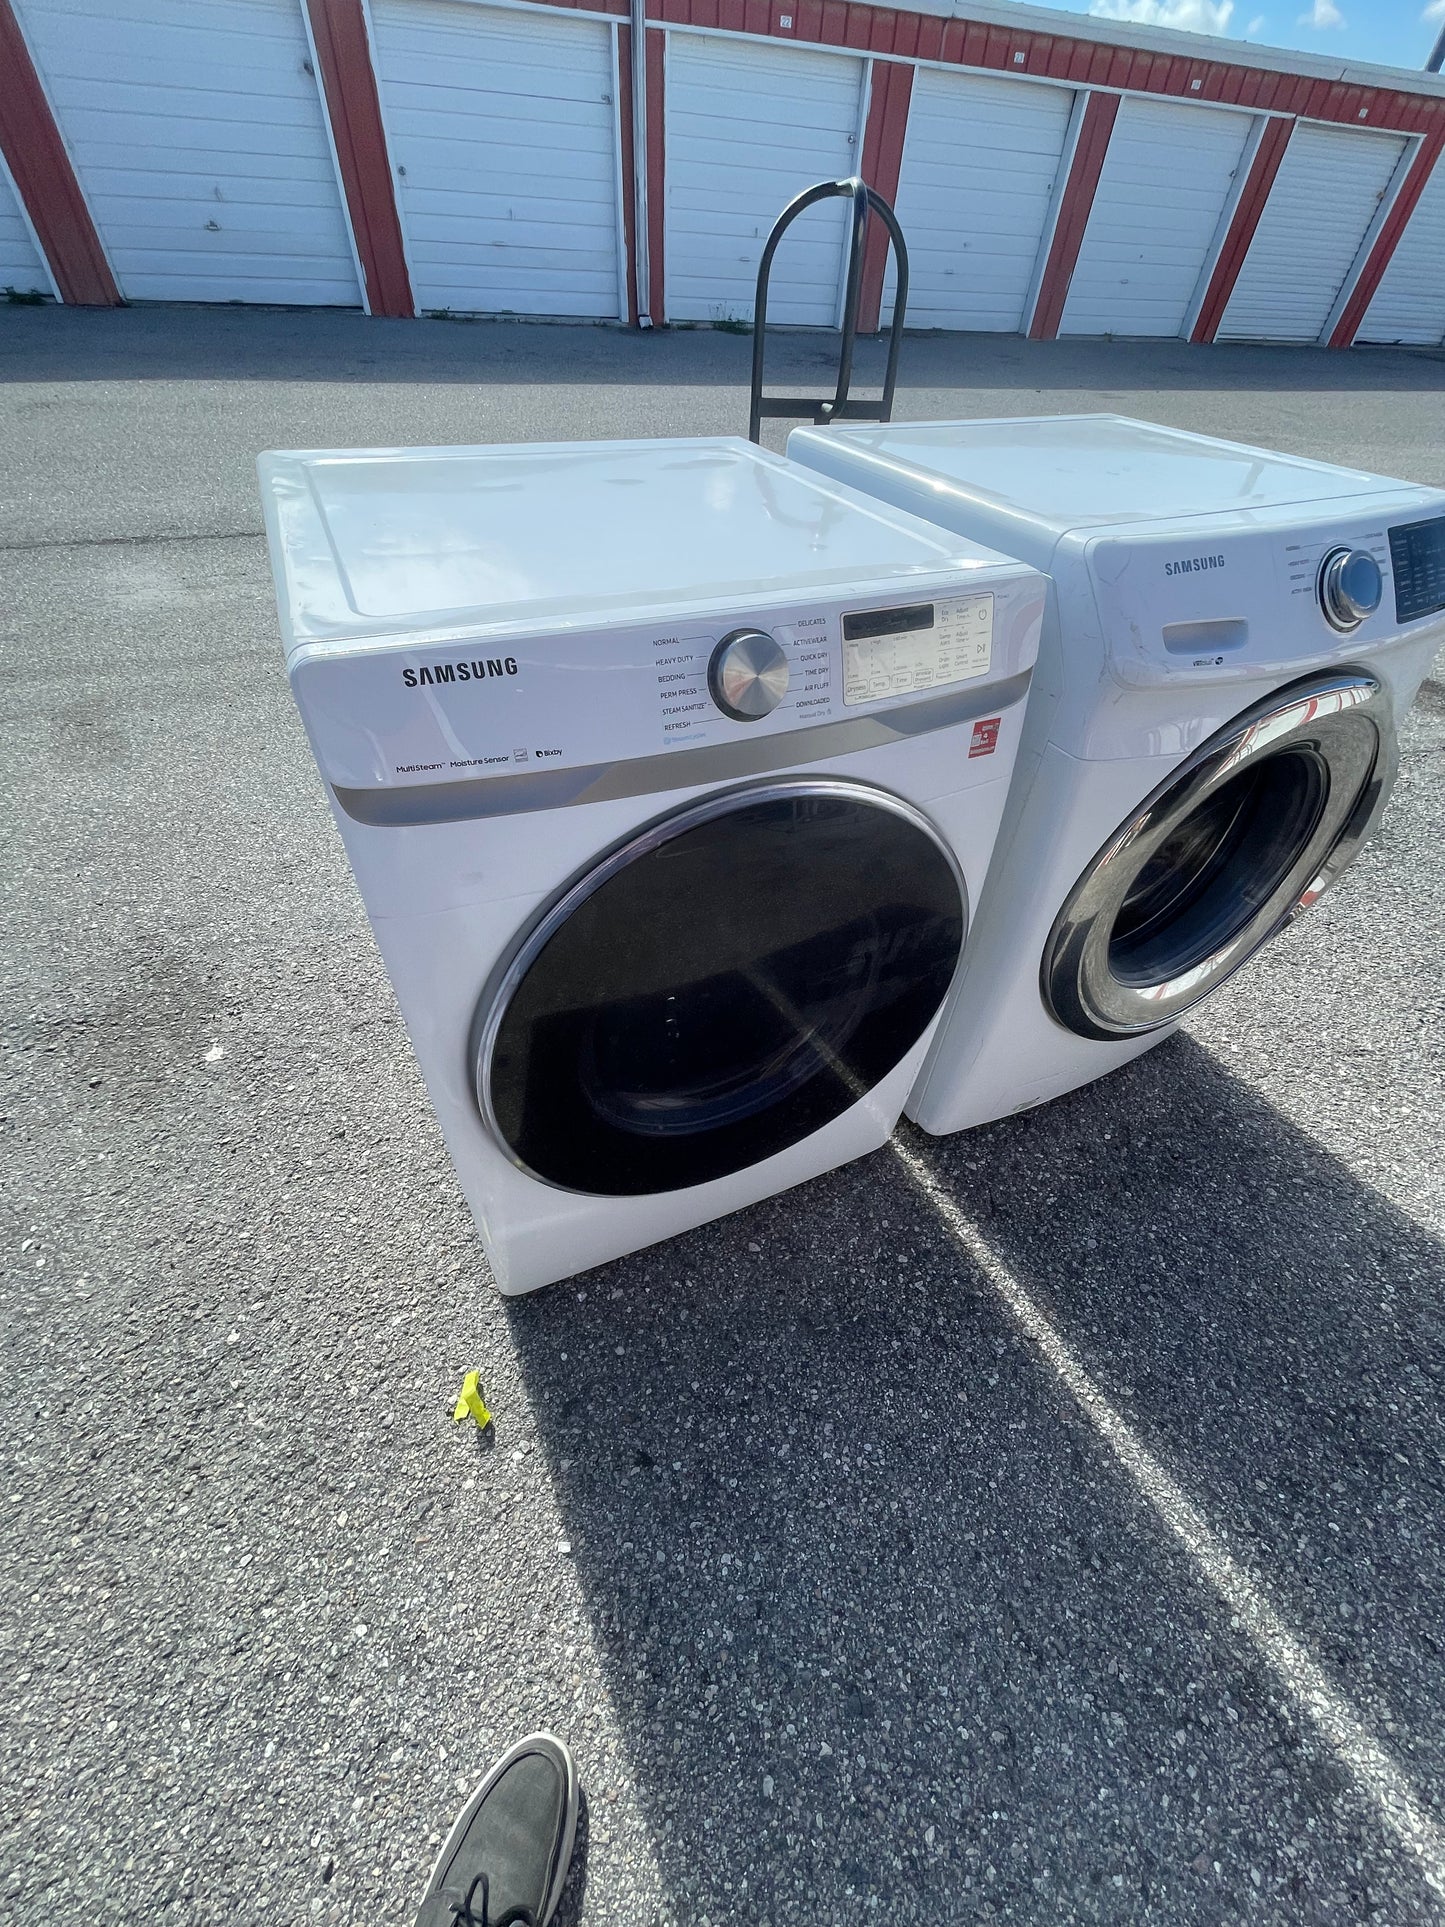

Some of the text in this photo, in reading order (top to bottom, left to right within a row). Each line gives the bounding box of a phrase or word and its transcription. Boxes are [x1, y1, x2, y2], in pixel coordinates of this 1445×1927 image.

[781, 16, 791, 27] 22
[1165, 555, 1225, 576] SAMSUNG
[798, 618, 826, 627] DELICATES
[653, 638, 680, 646] NORMAL
[793, 636, 827, 646] ACTIVEWEAR
[655, 655, 693, 666] HEAVY DUTY
[800, 652, 828, 662] QUICK DRY
[402, 657, 518, 687] SAMSUNG
[658, 673, 686, 683] BEDDING
[814, 682, 829, 690] FLUFF
[660, 688, 697, 699] PERM PRESS
[796, 697, 830, 708] DOWNLOADED
[662, 706, 681, 716] STEAM
[664, 721, 691, 731] REFRESH
[544, 749, 563, 757] Bixby
[450, 758, 483, 768] Moisture
[484, 755, 510, 764] Sensor
